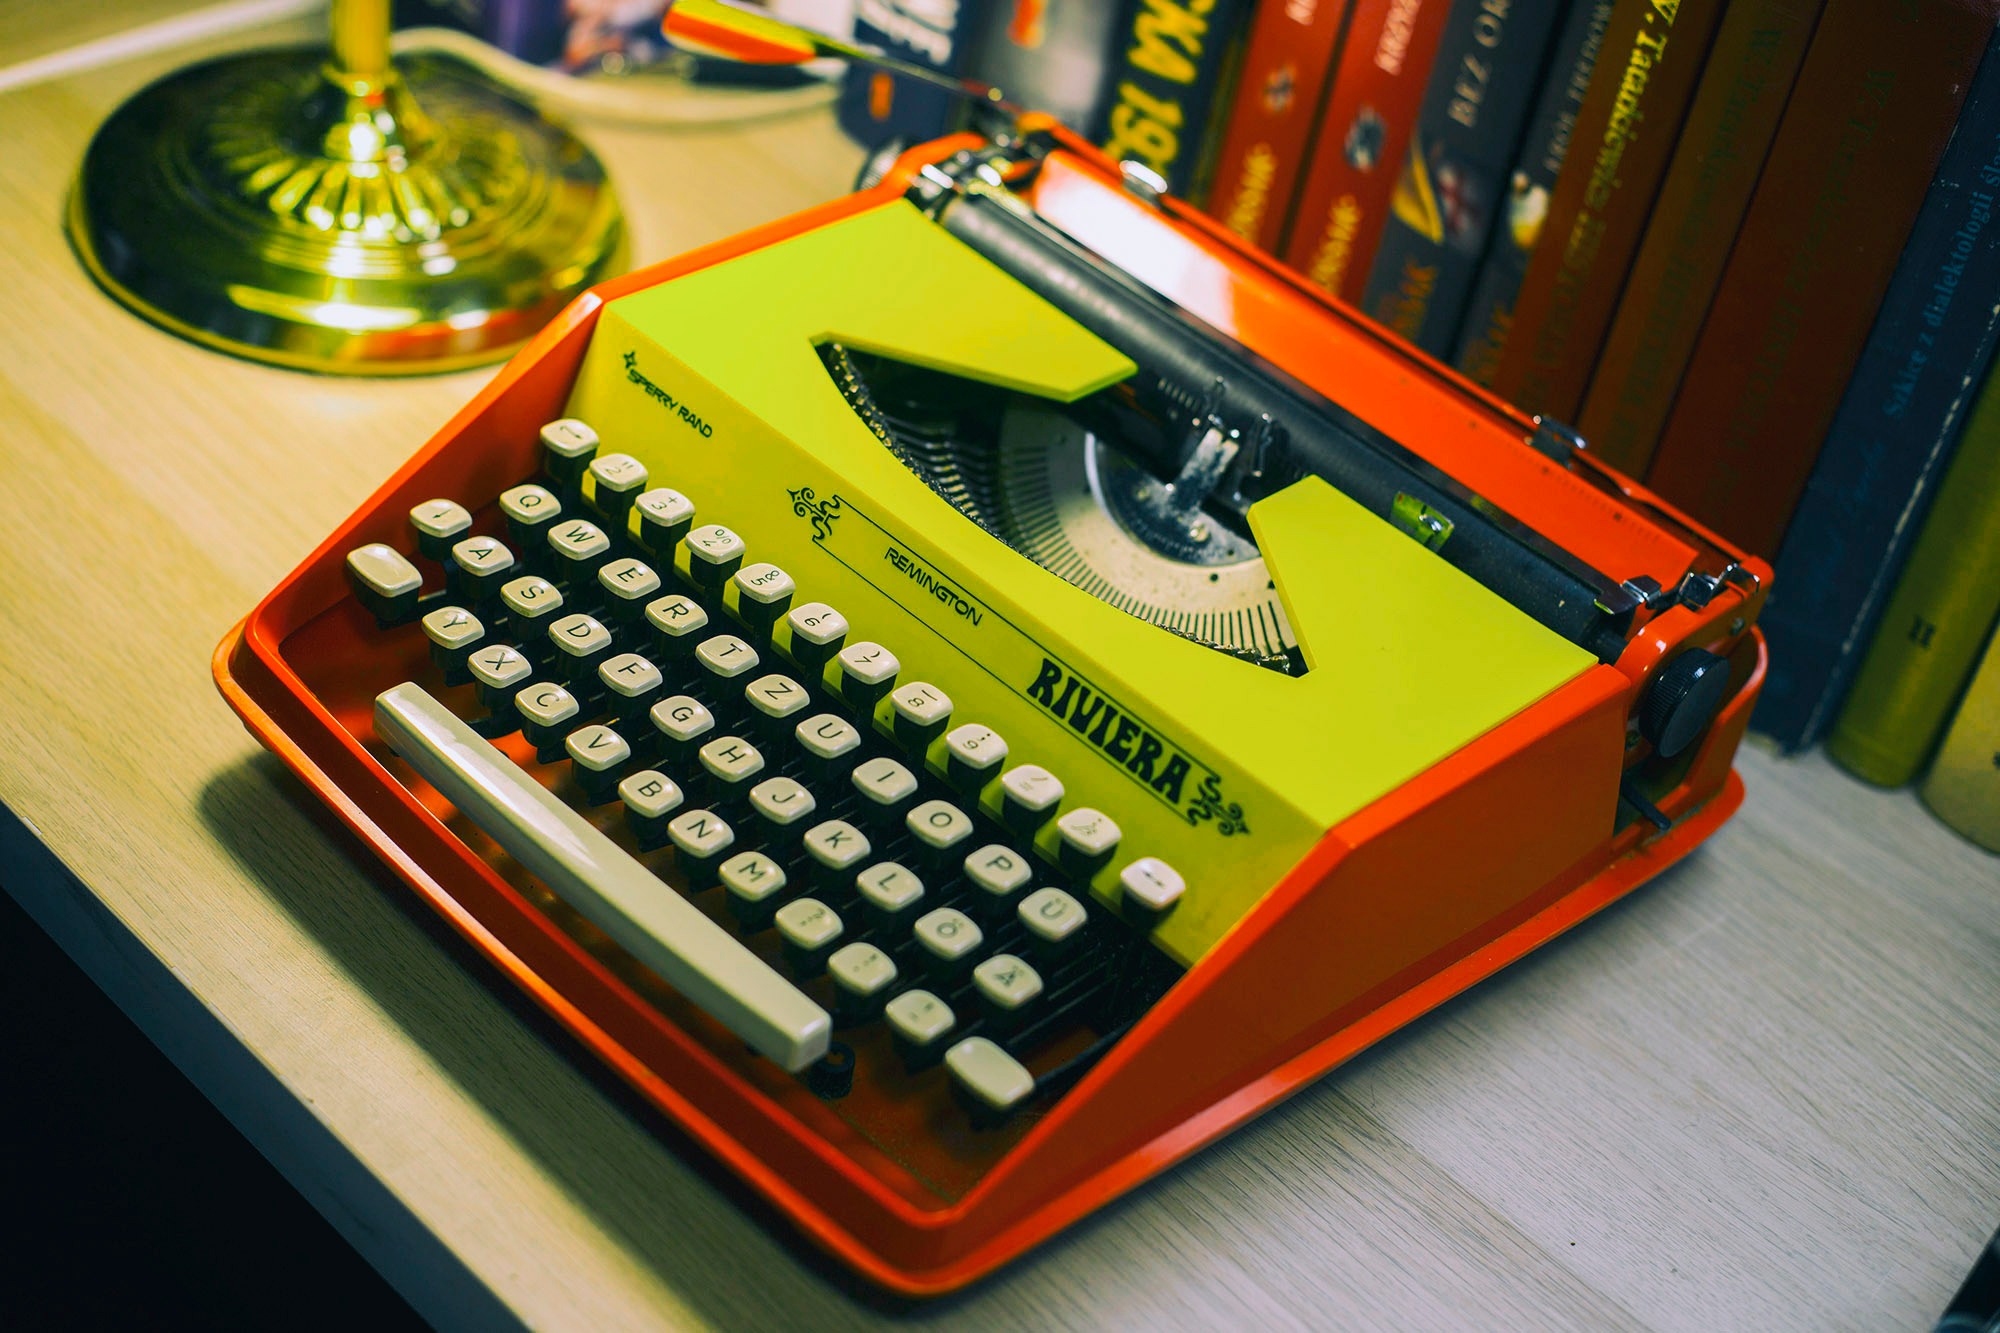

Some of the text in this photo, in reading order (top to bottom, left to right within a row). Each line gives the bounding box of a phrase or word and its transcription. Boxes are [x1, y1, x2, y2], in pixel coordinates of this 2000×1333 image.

[1923, 190, 1995, 328] dialektologii
[1918, 331, 1934, 348] z
[1882, 349, 1928, 419] Szkice
[626, 367, 713, 438] SPERRY RAND
[605, 467, 622, 476] 2
[519, 494, 542, 508] Q
[651, 501, 668, 511] 3
[566, 525, 595, 544] W
[702, 539, 717, 548] 4
[468, 546, 494, 561] A
[617, 567, 643, 582] E
[751, 578, 766, 587] 5
[520, 585, 545, 600] S
[885, 547, 983, 626] REMINGTON
[663, 602, 689, 619] R
[442, 615, 468, 630] Y
[567, 622, 591, 638] D
[804, 617, 820, 627] 6
[719, 642, 743, 658] T
[484, 653, 516, 671] X
[854, 655, 873, 664] 7
[618, 662, 646, 676] F
[764, 682, 794, 700] Z
[536, 692, 560, 708] C
[907, 697, 925, 708] 8
[671, 706, 695, 723] G
[817, 721, 843, 740] U
[1027, 657, 1194, 809] RIVIERA
[588, 733, 612, 749] V
[962, 740, 979, 750] 9
[718, 745, 745, 764] H
[876, 770, 896, 784] I
[638, 780, 662, 798] B
[772, 791, 796, 805] J
[930, 812, 953, 828] O
[687, 819, 713, 839] N
[825, 831, 853, 849] K
[738, 861, 765, 883] M
[986, 855, 1013, 875] P
[878, 874, 900, 892] L
